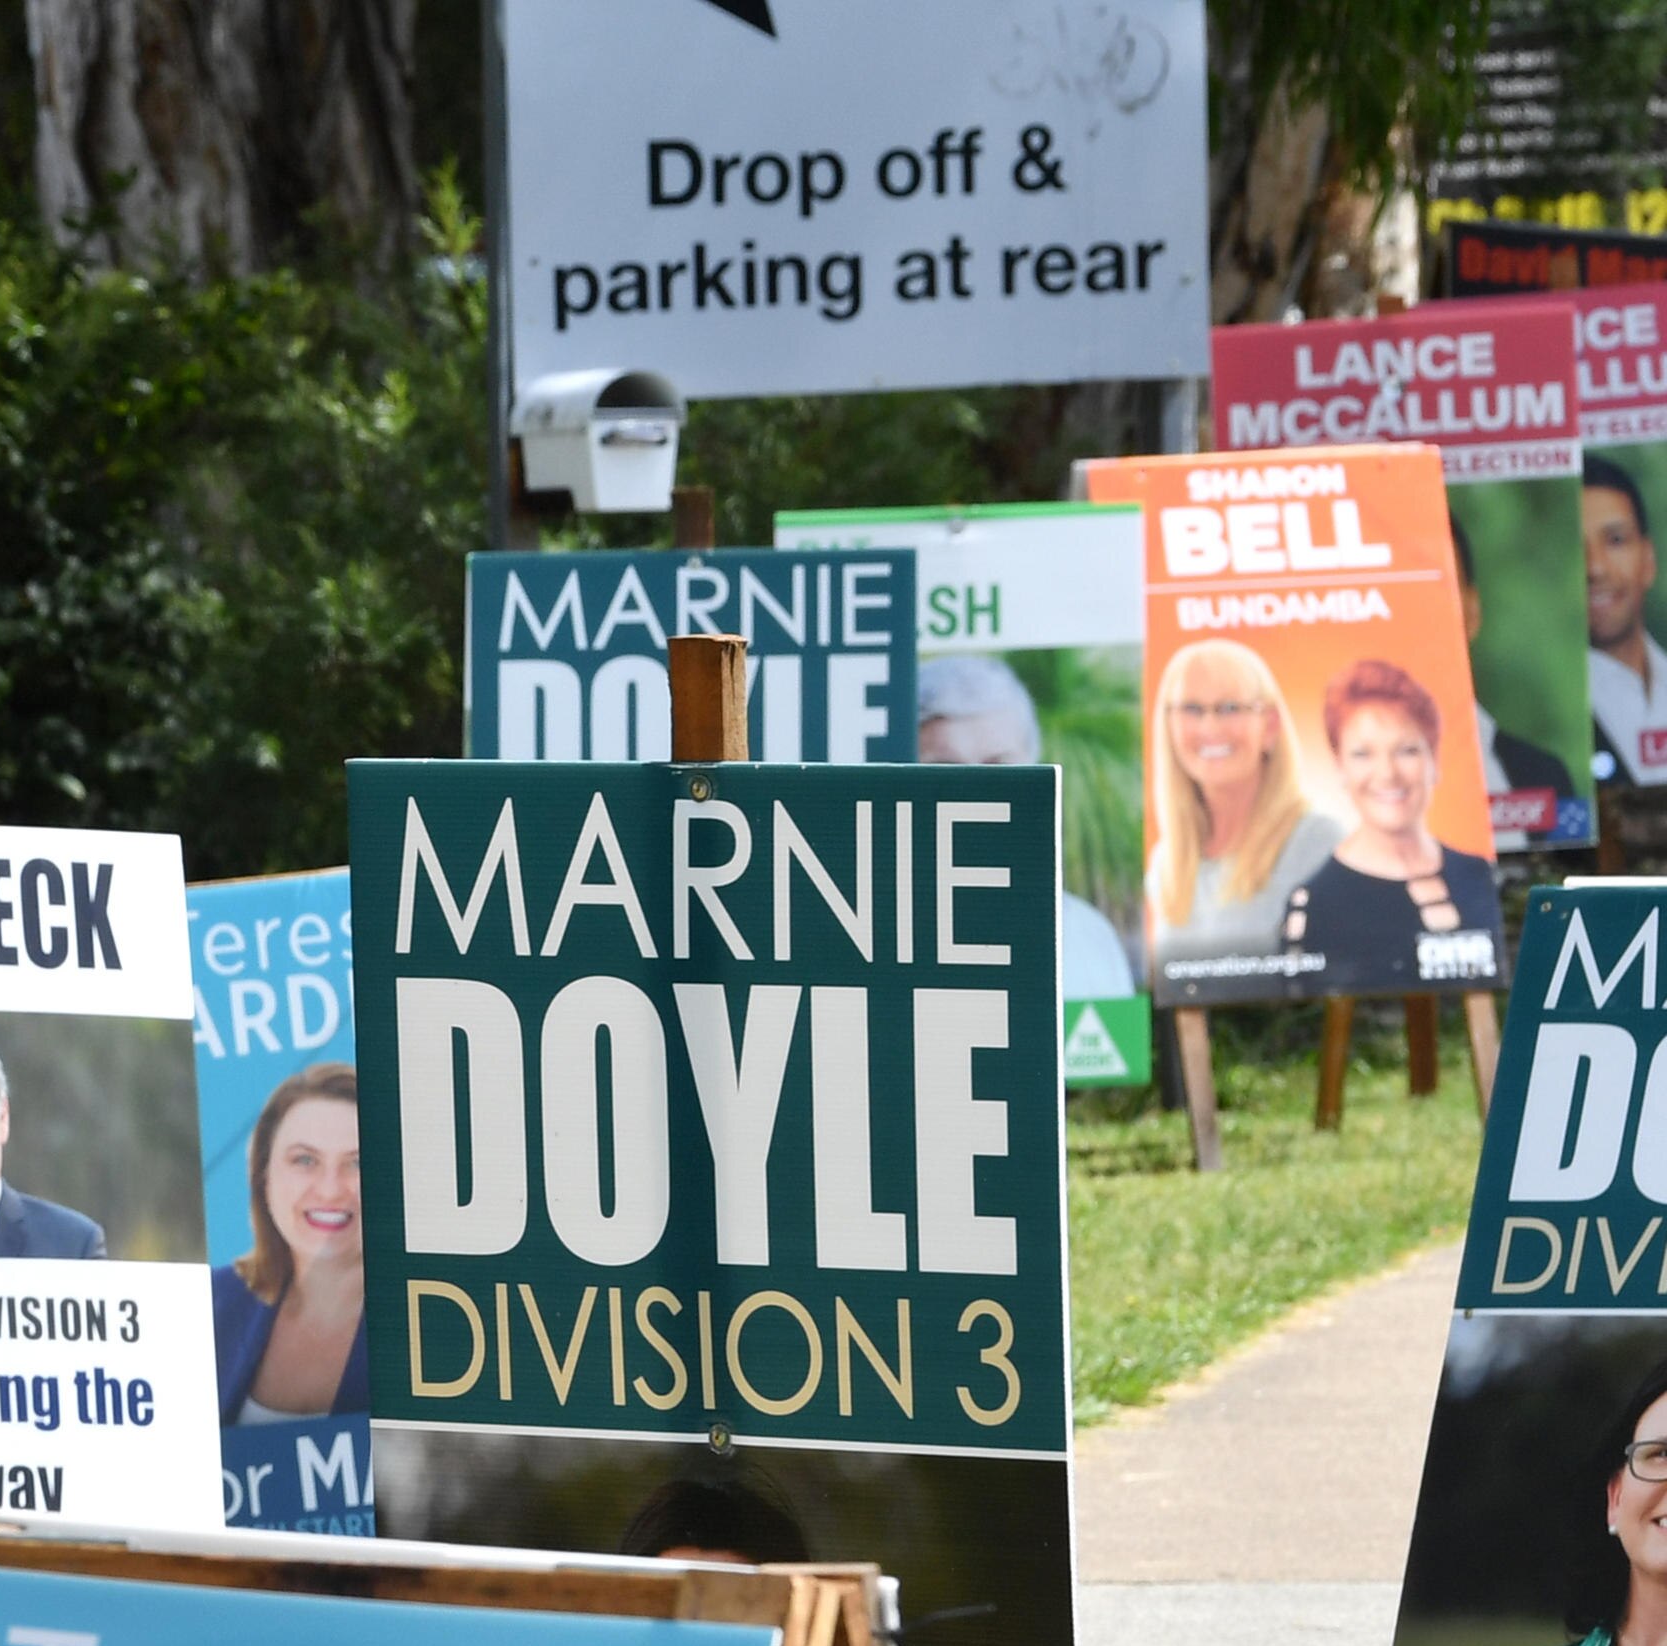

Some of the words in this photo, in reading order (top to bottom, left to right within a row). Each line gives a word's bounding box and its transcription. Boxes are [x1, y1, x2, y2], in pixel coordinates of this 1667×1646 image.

[646, 139, 847, 218] Drop
[876, 126, 984, 197] off
[1012, 122, 1067, 192] &
[552, 240, 864, 331] parking
[894, 236, 973, 300] at
[1001, 238, 1165, 296] rear
[1293, 332, 1497, 390] LANCE
[1228, 381, 1565, 448] MCCALLUM
[1186, 463, 1346, 502] SHARON
[1158, 498, 1393, 579] BELL
[497, 560, 895, 653] MARNIE
[1177, 588, 1392, 631] BUNDAMBA
[394, 790, 1014, 966] MARNIE
[394, 975, 1020, 1276] DOYLE
[118, 1299, 141, 1343] 3
[406, 1278, 916, 1421] DIVISION
[955, 1298, 1023, 1428] 3
[73, 1366, 155, 1427] the
